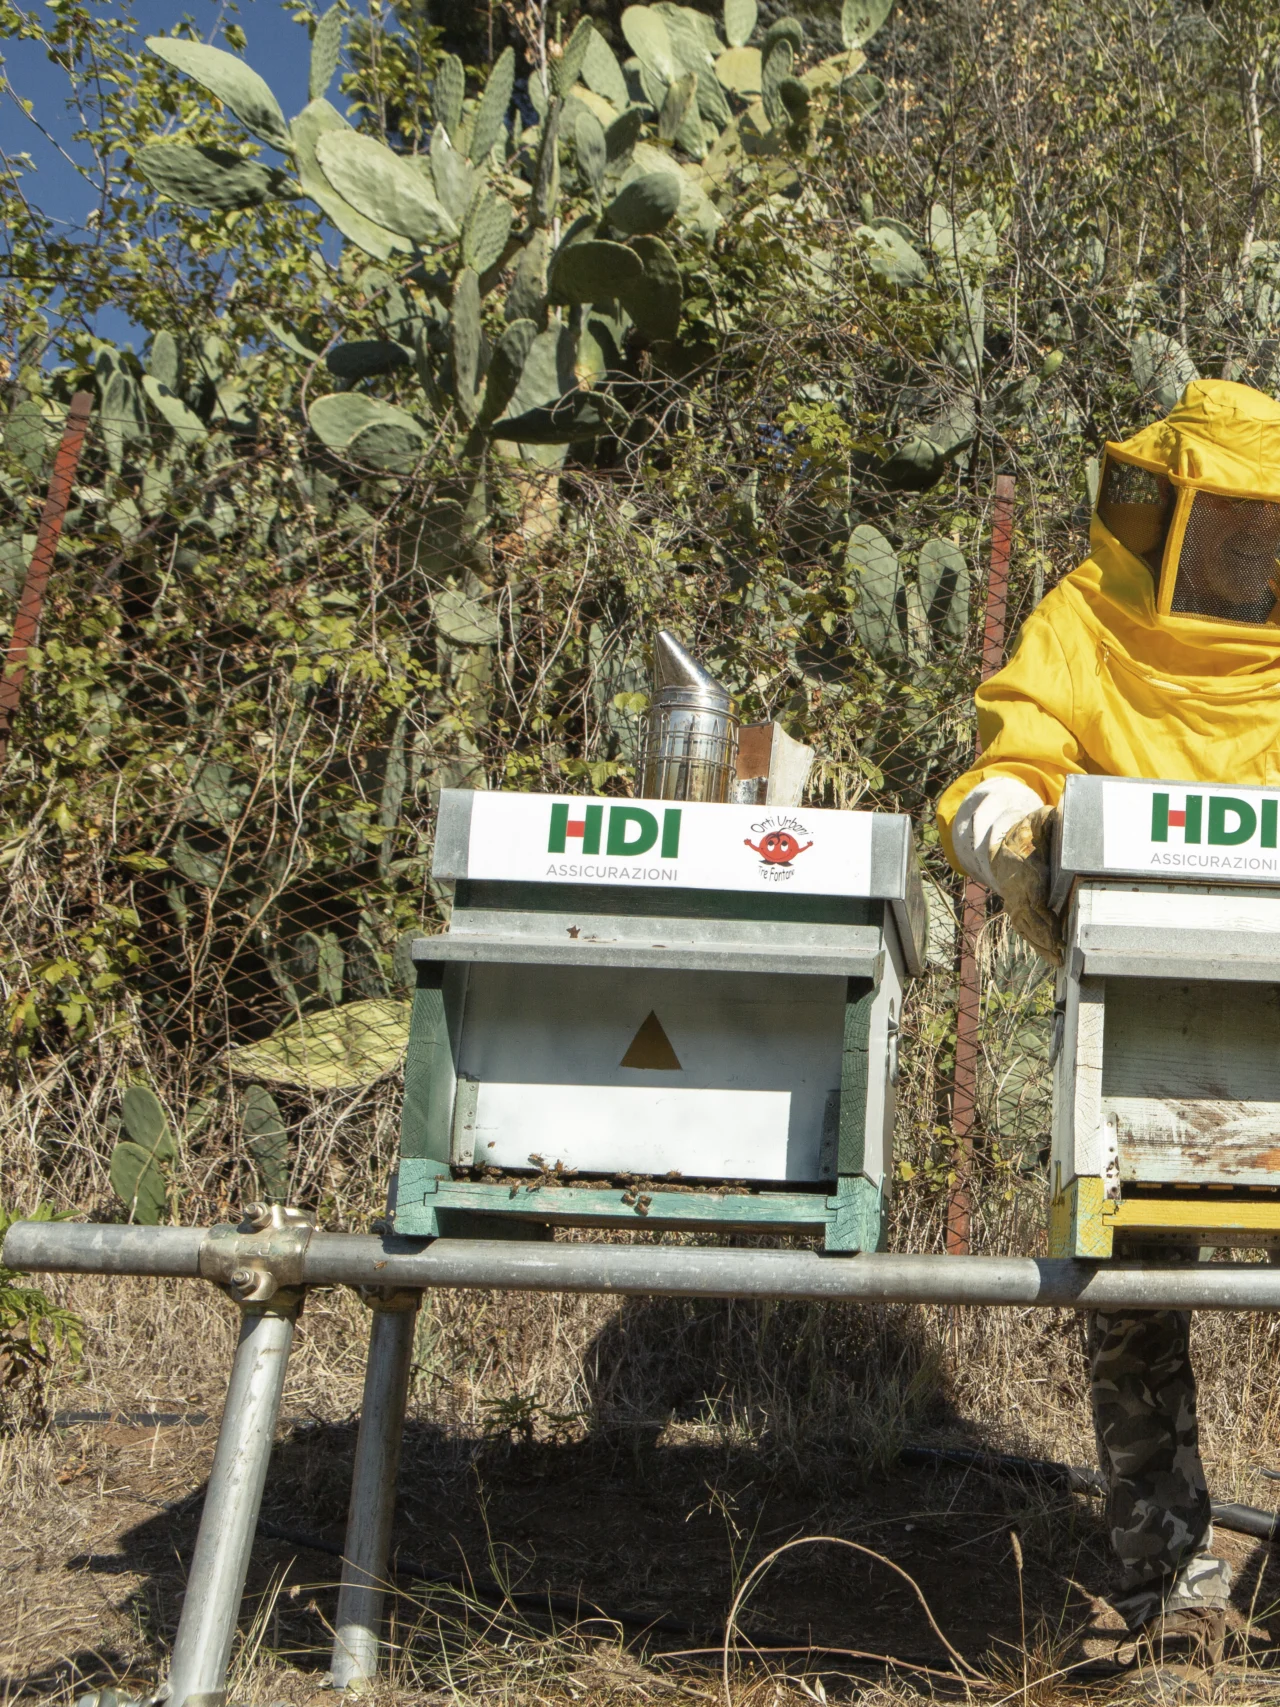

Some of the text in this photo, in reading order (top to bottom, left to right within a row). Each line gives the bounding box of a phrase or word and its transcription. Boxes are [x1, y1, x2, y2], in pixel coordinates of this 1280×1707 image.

[750, 815, 814, 836] Orti Urbani
[1151, 792, 1278, 849] HDI
[548, 803, 682, 859] HDI
[1150, 852, 1278, 871] ASSICURAZIONI
[546, 864, 678, 882] ASSICURAZIONI
[758, 865, 769, 880] Tre
